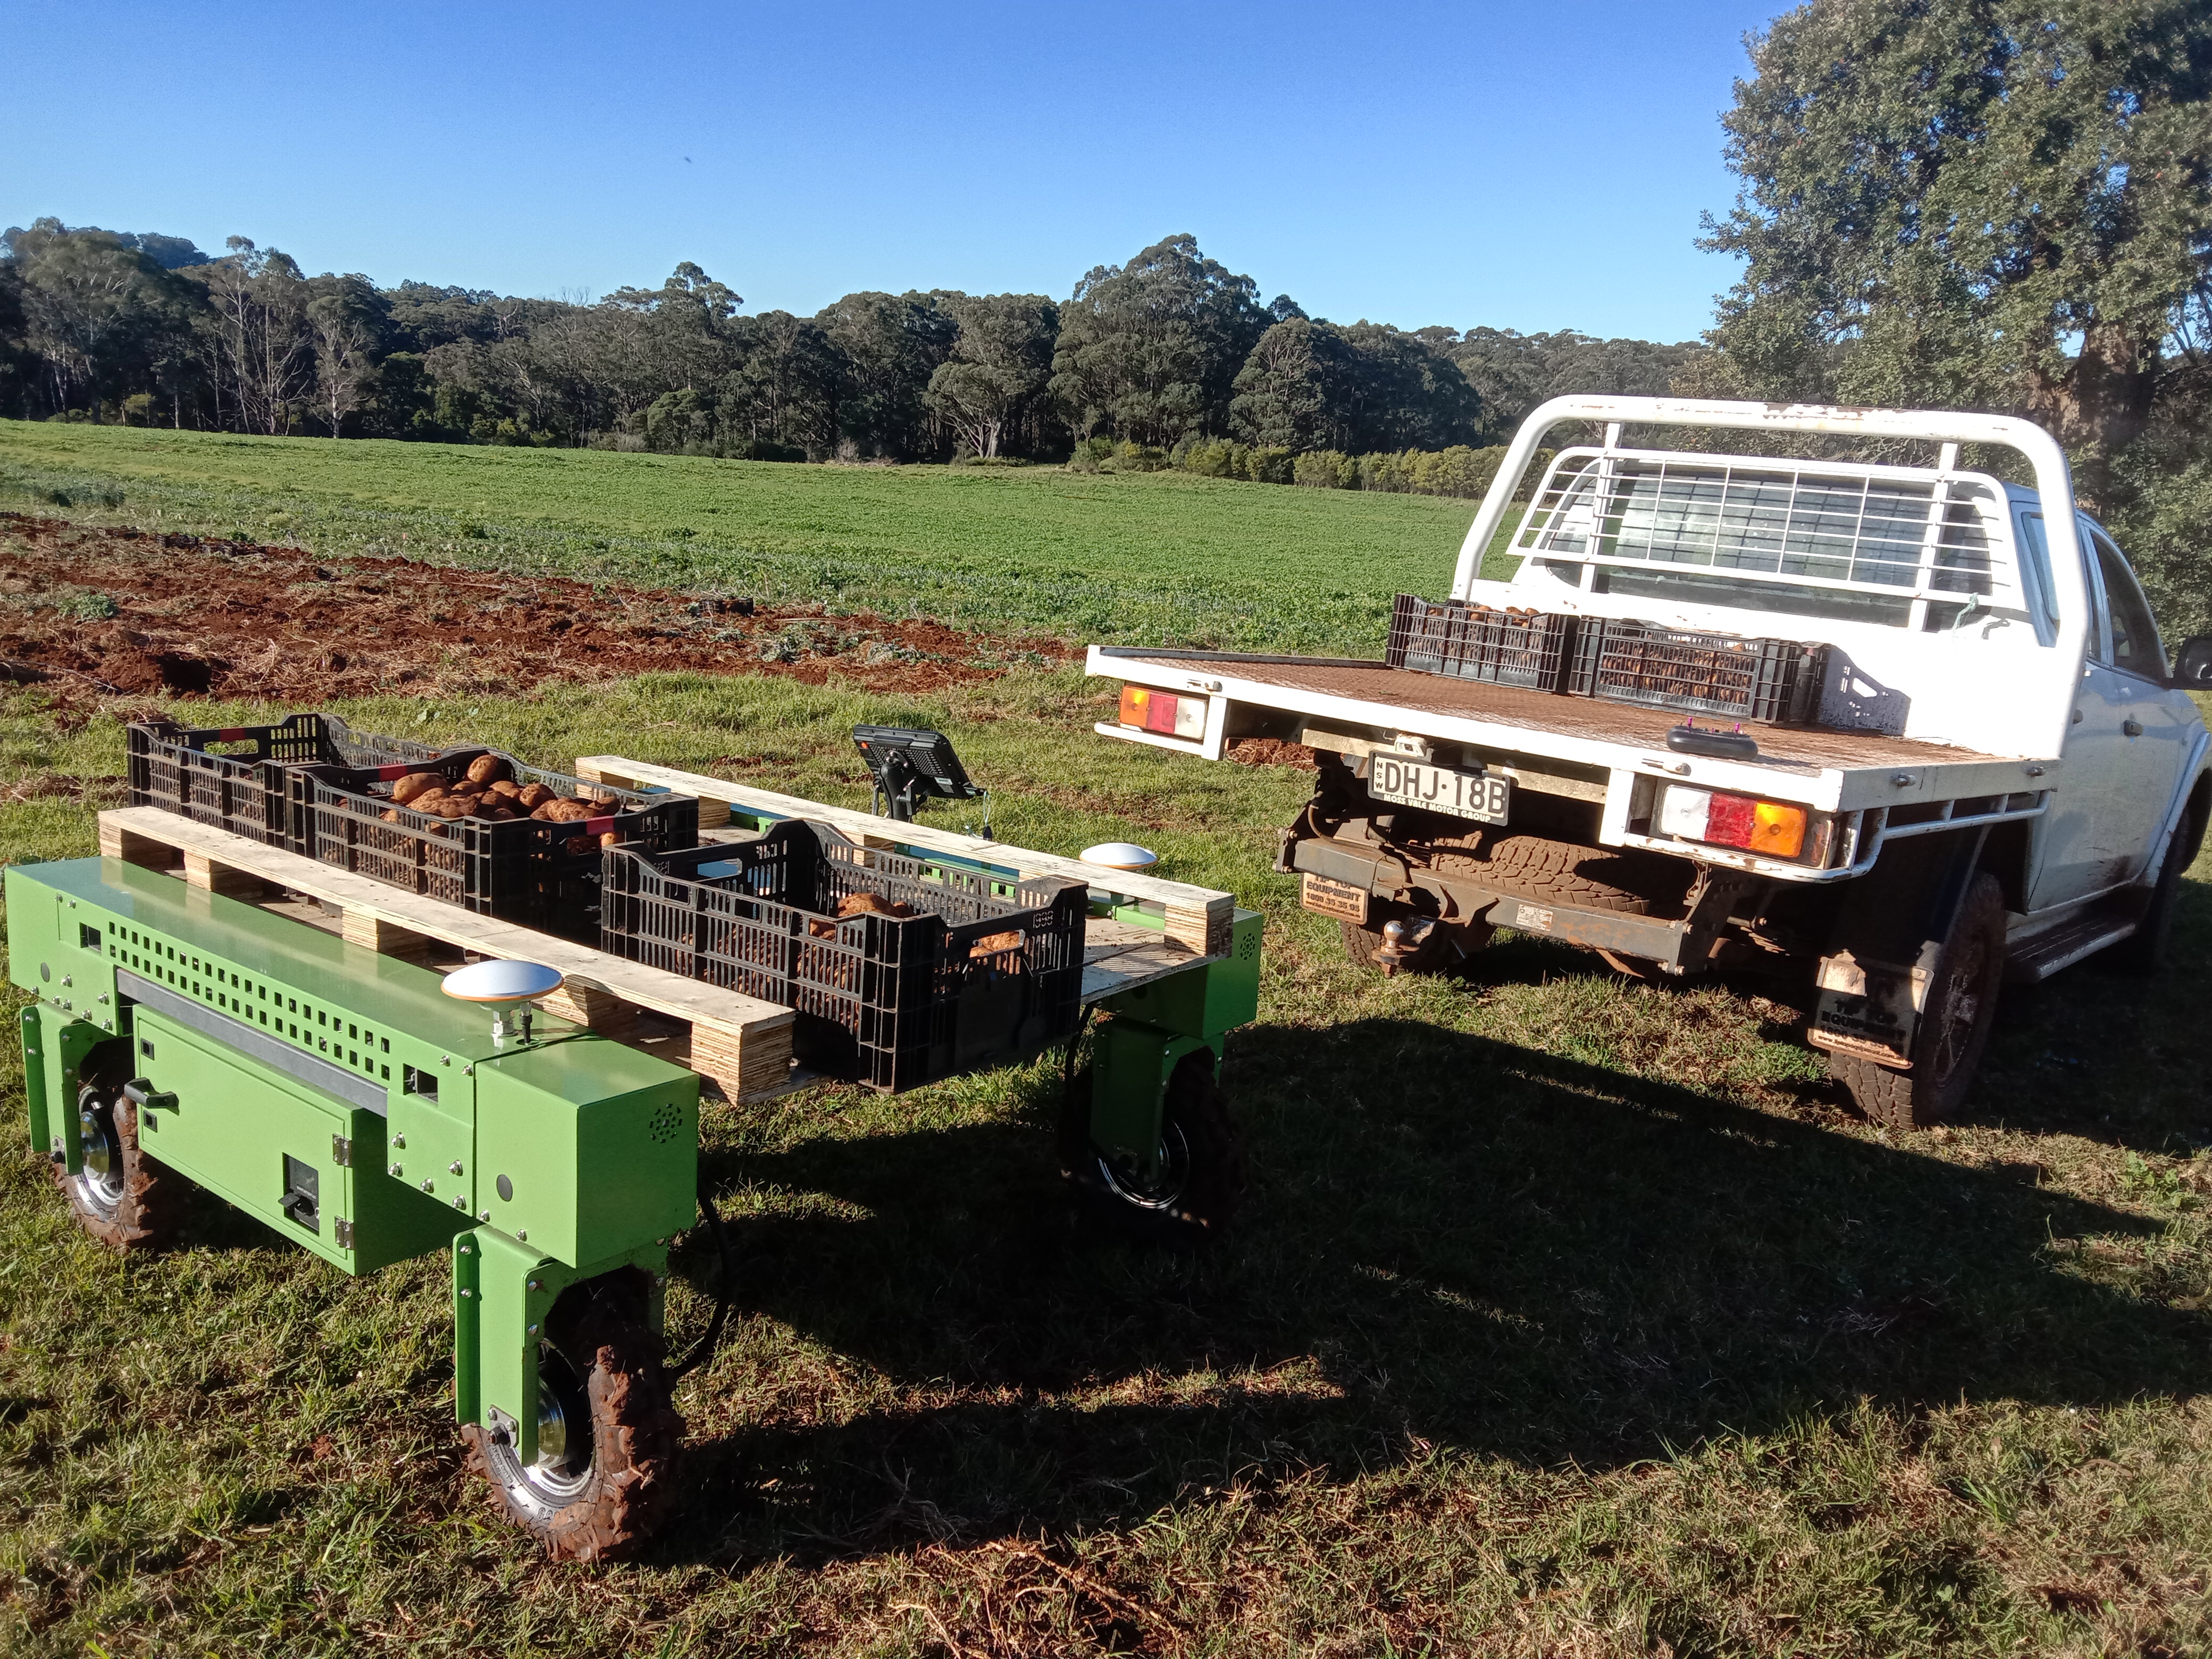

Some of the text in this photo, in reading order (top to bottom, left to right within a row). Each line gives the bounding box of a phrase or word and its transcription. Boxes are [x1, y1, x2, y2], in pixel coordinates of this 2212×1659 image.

[1384, 794, 1491, 823] MOSS VALE MOTOR GROUP
[1306, 881, 1361, 901] EQUIPMENT
[1306, 892, 1324, 902] 1800
[1349, 904, 1360, 912] 95
